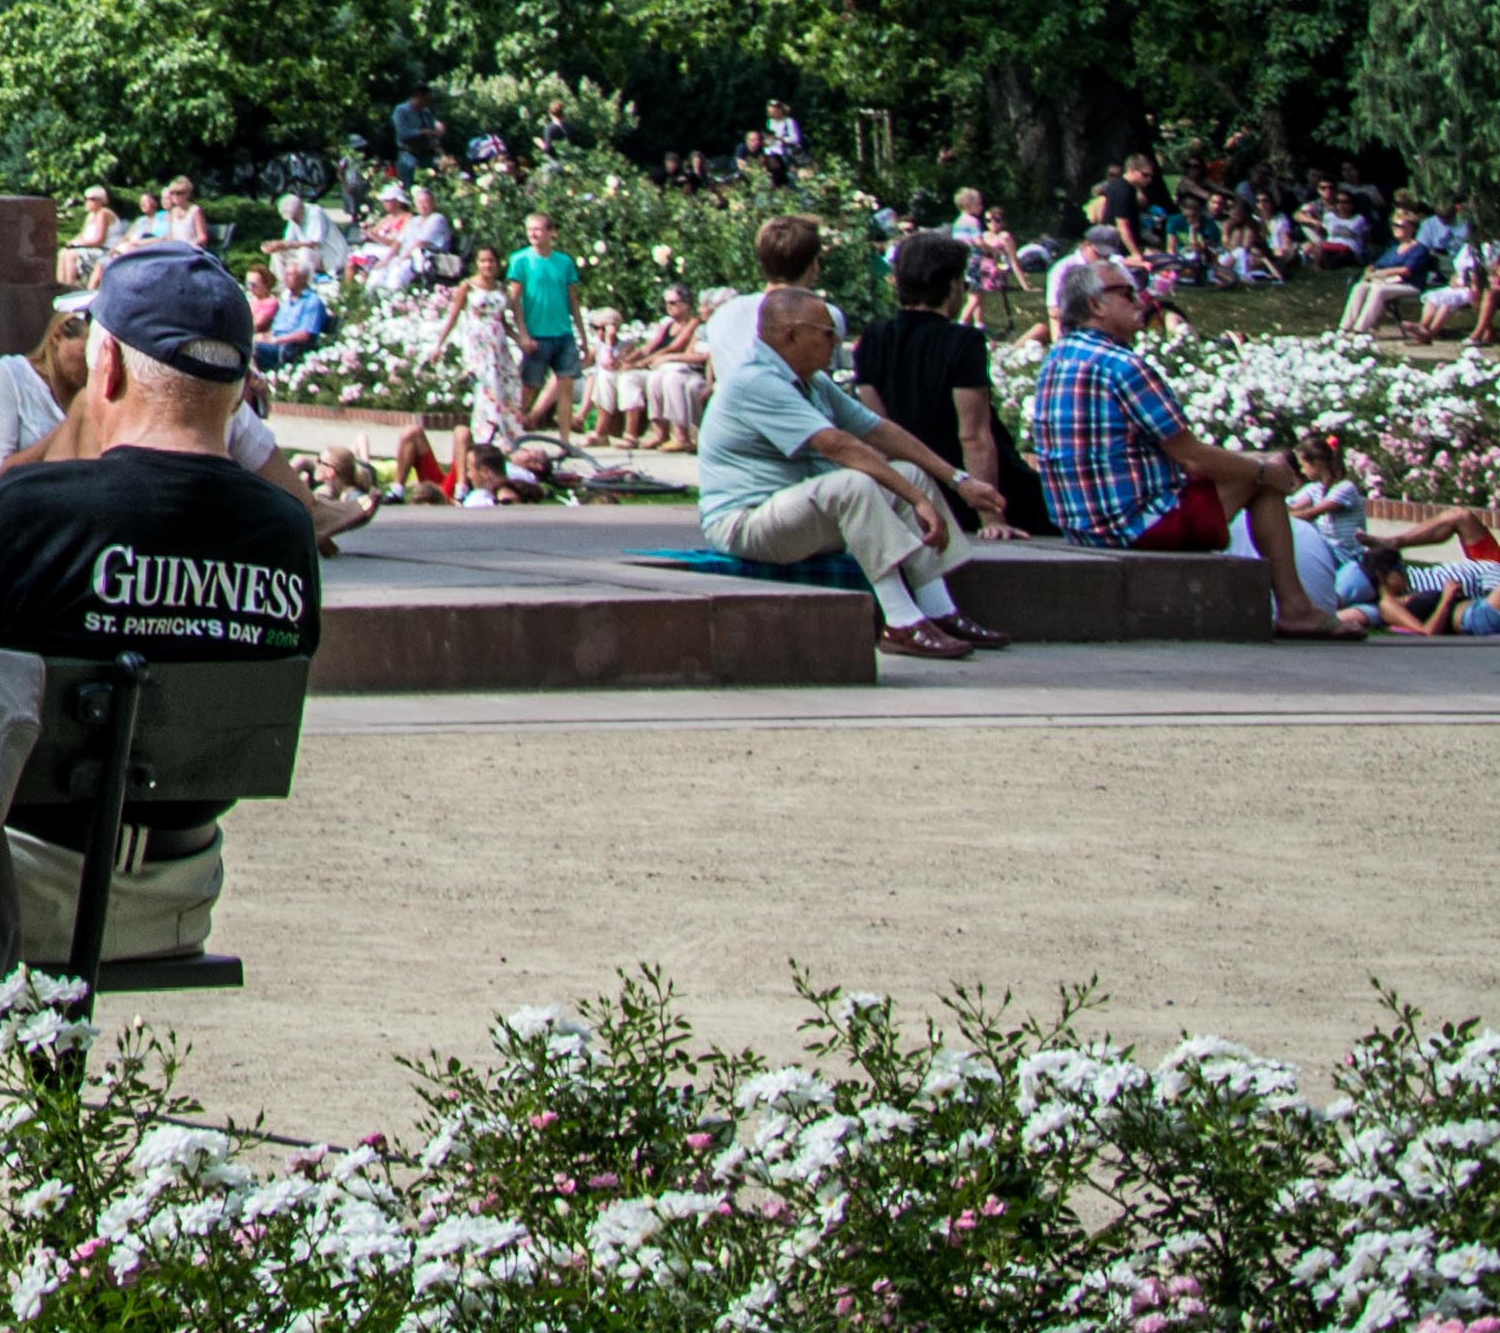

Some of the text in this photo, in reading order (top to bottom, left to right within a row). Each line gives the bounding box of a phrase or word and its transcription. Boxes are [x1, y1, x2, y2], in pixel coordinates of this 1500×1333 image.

[92, 544, 303, 621] GUINNESS
[85, 612, 117, 633] ST.
[124, 617, 224, 637] PATRICK'S
[229, 622, 262, 645] DAY
